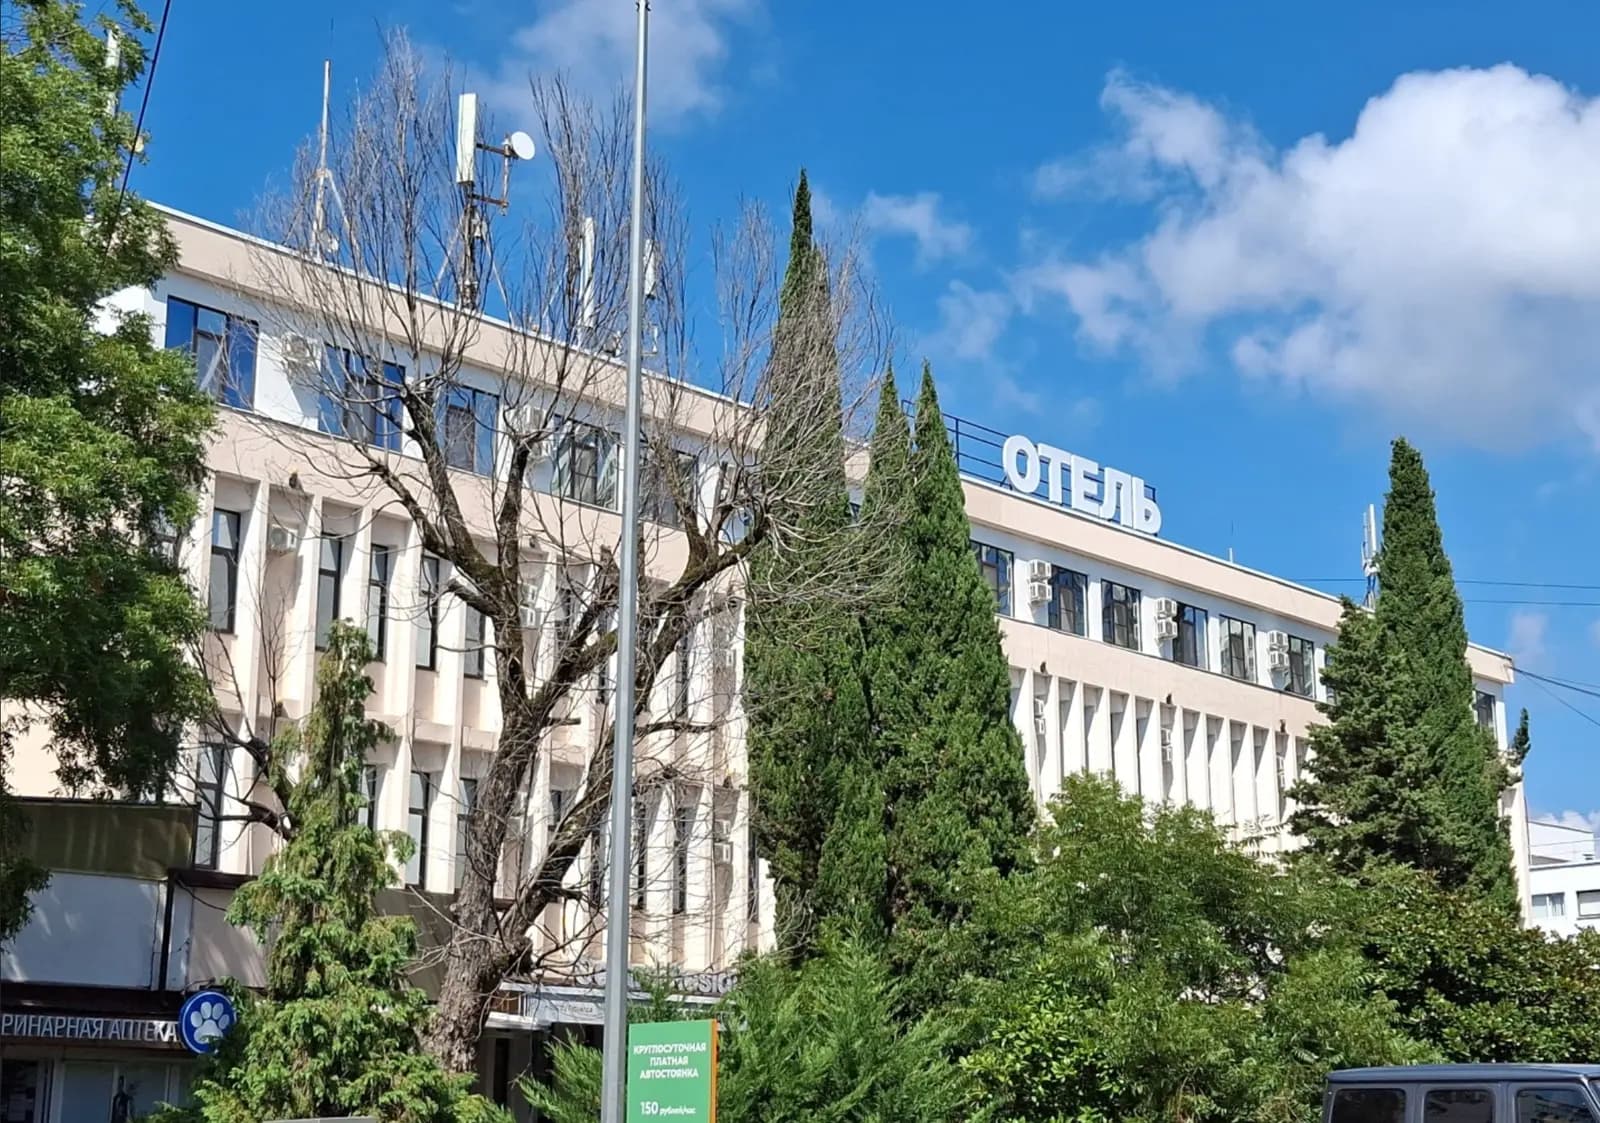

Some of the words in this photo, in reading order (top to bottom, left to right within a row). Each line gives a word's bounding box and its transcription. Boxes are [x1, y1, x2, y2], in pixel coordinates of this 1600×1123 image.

[1002, 434, 1162, 534] ОТЕЛЬ
[1, 1013, 103, 1039] РИНАРНАЯ
[108, 1018, 179, 1042] АПТЕКА
[633, 1042, 706, 1055] КРУГЛОСУТОЧНАЯ
[649, 1055, 689, 1066] ПЛАТНАЯ
[639, 1068, 699, 1080] АВТОСТОЯНКА
[640, 1101, 659, 1115] 150
